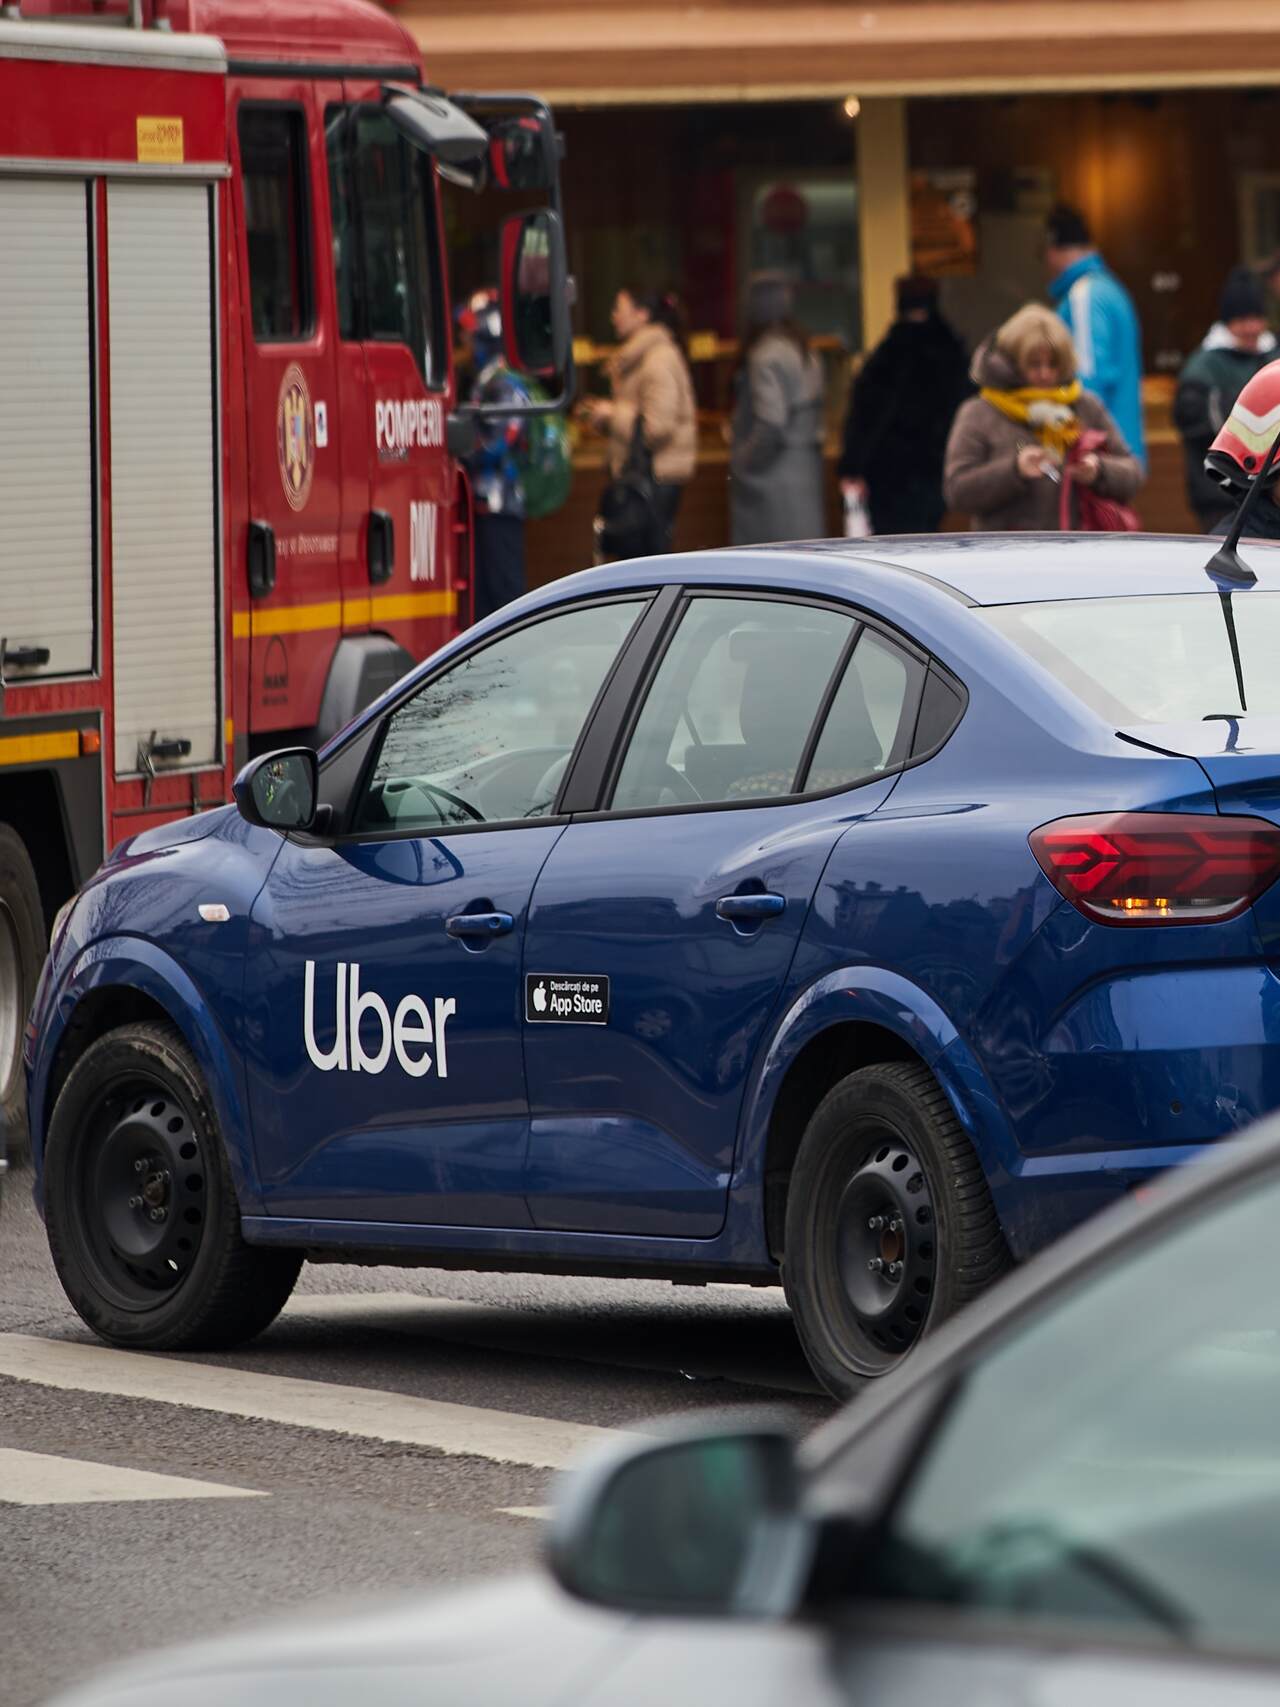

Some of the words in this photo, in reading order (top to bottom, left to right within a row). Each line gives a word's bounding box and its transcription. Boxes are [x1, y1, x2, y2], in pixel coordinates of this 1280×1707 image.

[582, 981, 590, 992] de
[590, 983, 599, 994] pe
[550, 993, 572, 1016] App
[573, 993, 602, 1014] Store
[304, 960, 456, 1078] Uber
